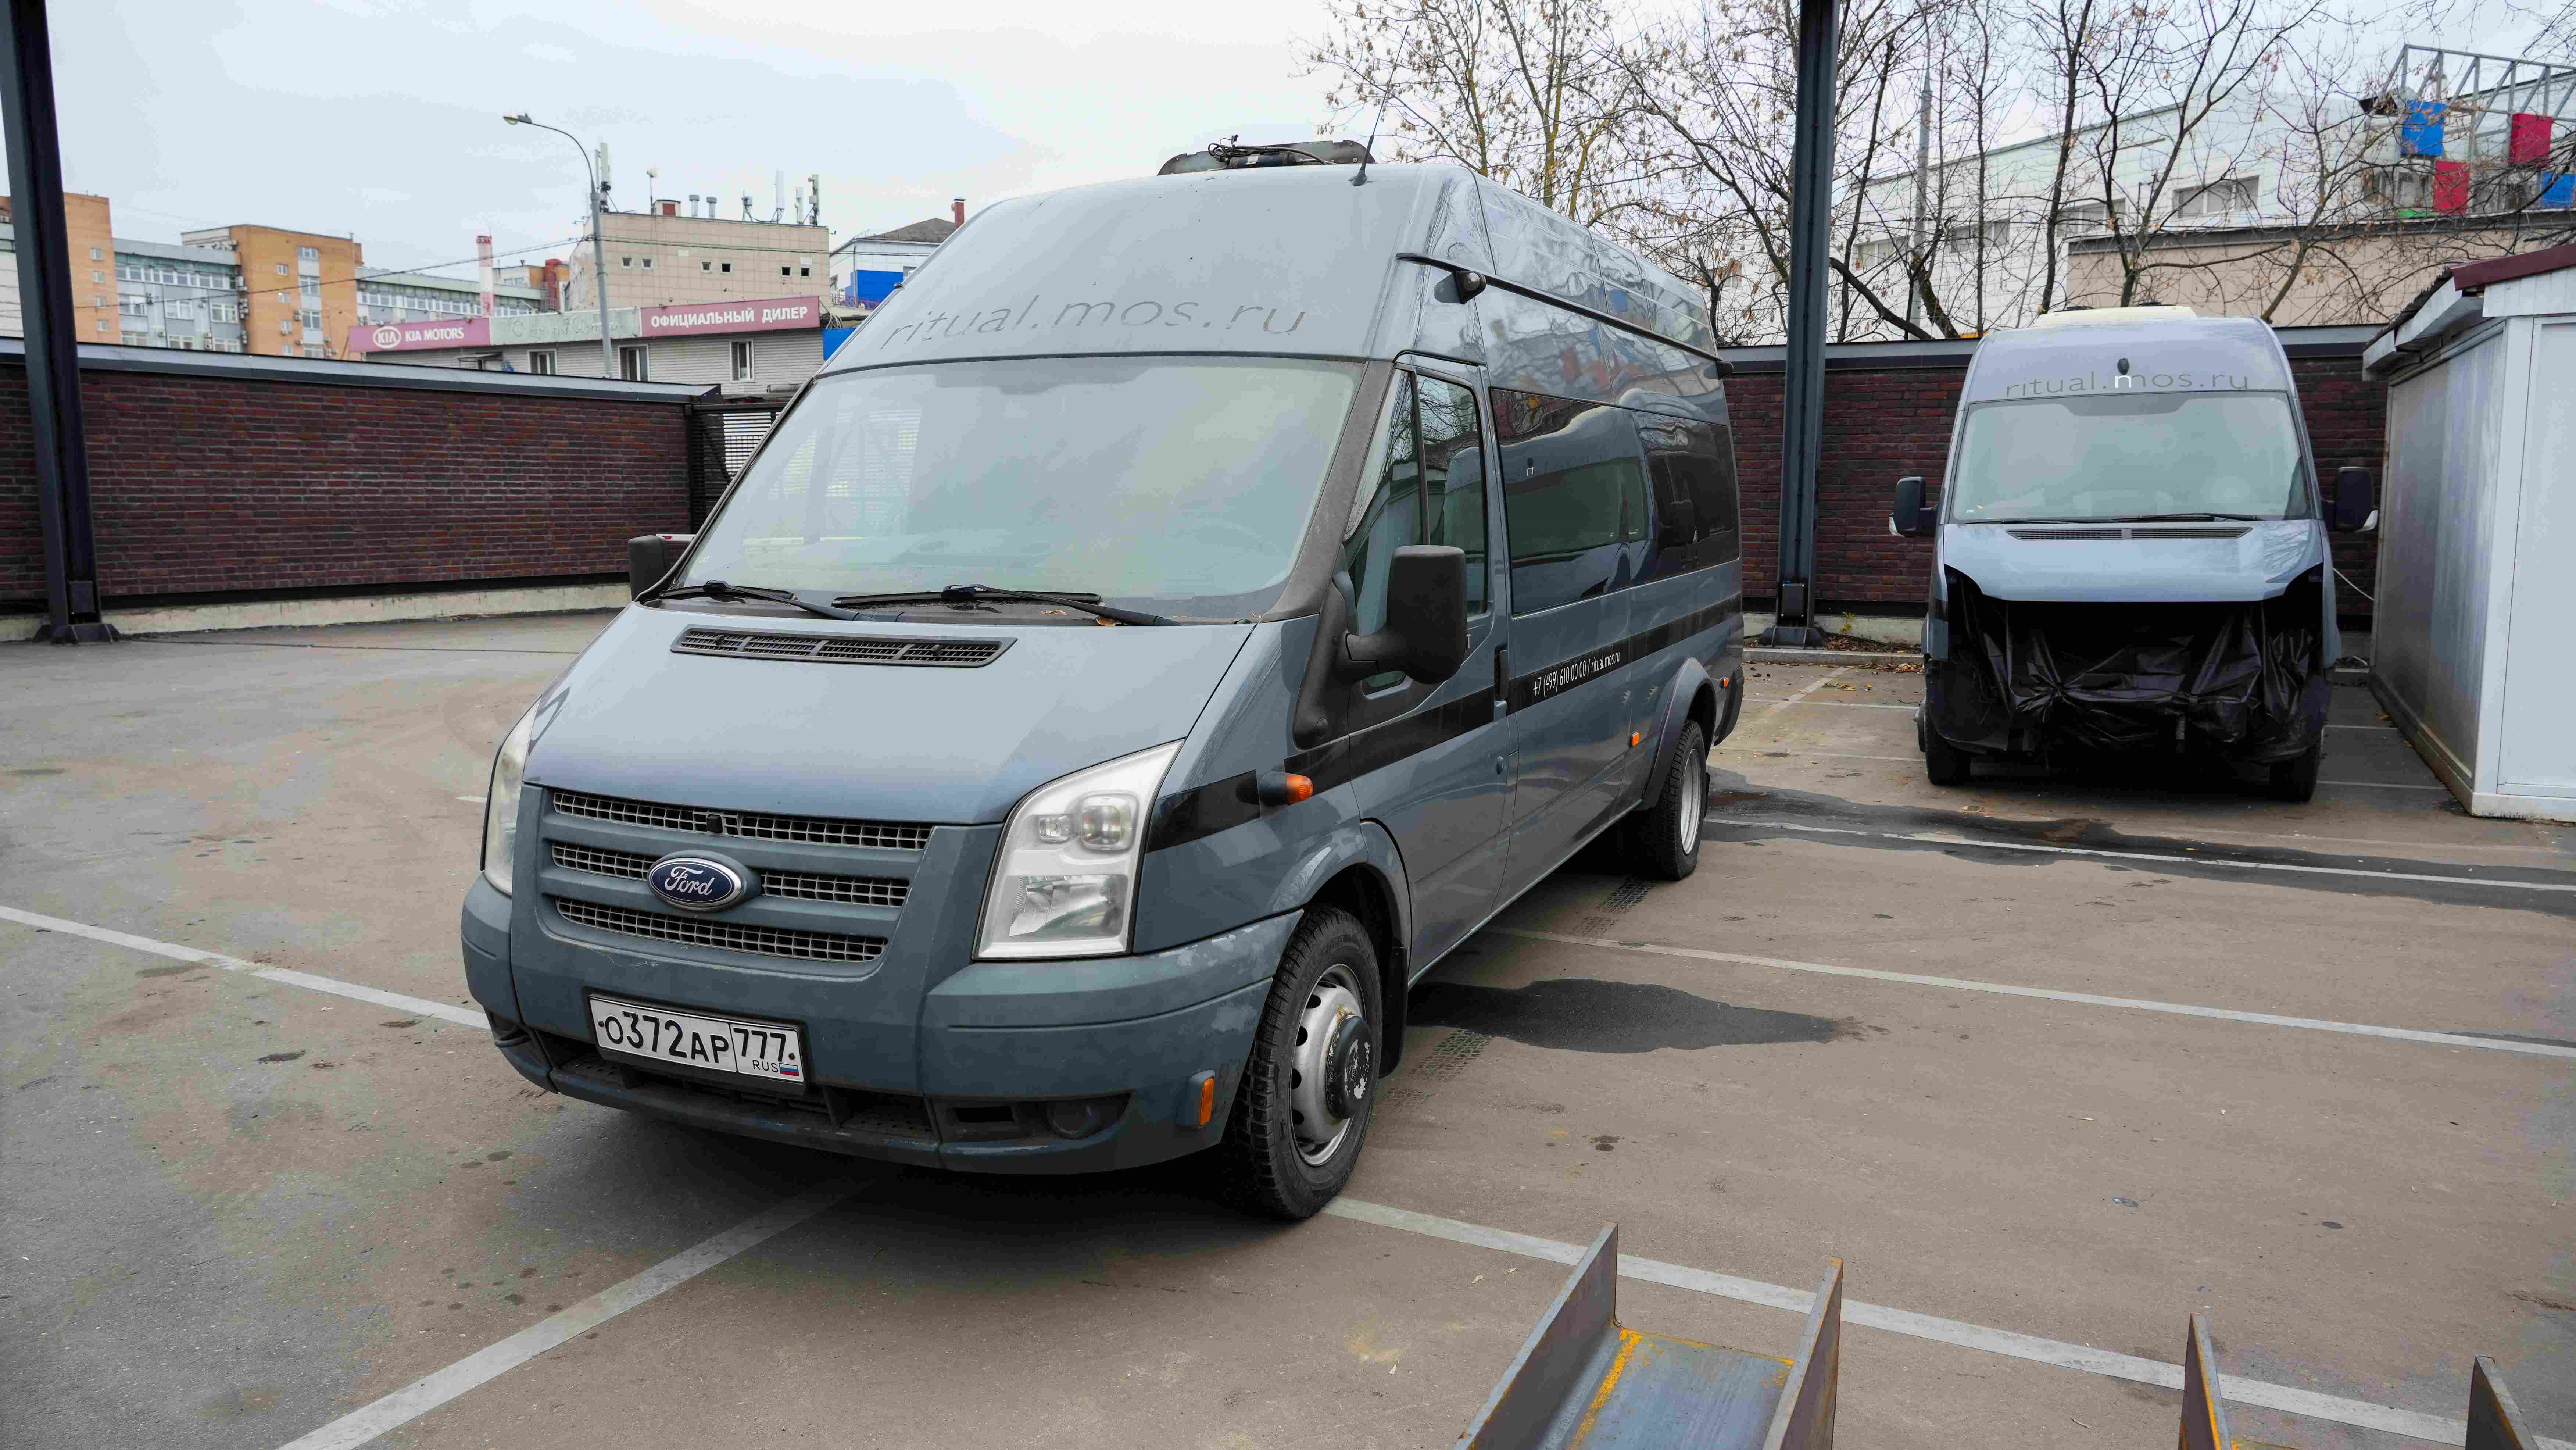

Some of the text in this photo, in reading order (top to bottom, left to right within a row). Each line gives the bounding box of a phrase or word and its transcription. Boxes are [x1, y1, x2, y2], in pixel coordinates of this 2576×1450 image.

[651, 307, 808, 328] ОФИЦИАЛЬНЫЙ ДИЛЕР
[880, 295, 1305, 350] ritual.mos.ru
[377, 327, 465, 344] KIA KIA MOTORS
[2006, 372, 2249, 398] ritual.mos.ru
[1533, 677, 1542, 696] +7
[1543, 671, 1558, 697] (499)
[1560, 667, 1569, 686] 610
[1571, 663, 1578, 681] 00
[1579, 660, 1586, 678] 00
[1591, 652, 1620, 673] ritual.mos.ru
[664, 865, 715, 896] Ford
[752, 1059, 779, 1073] RUS
